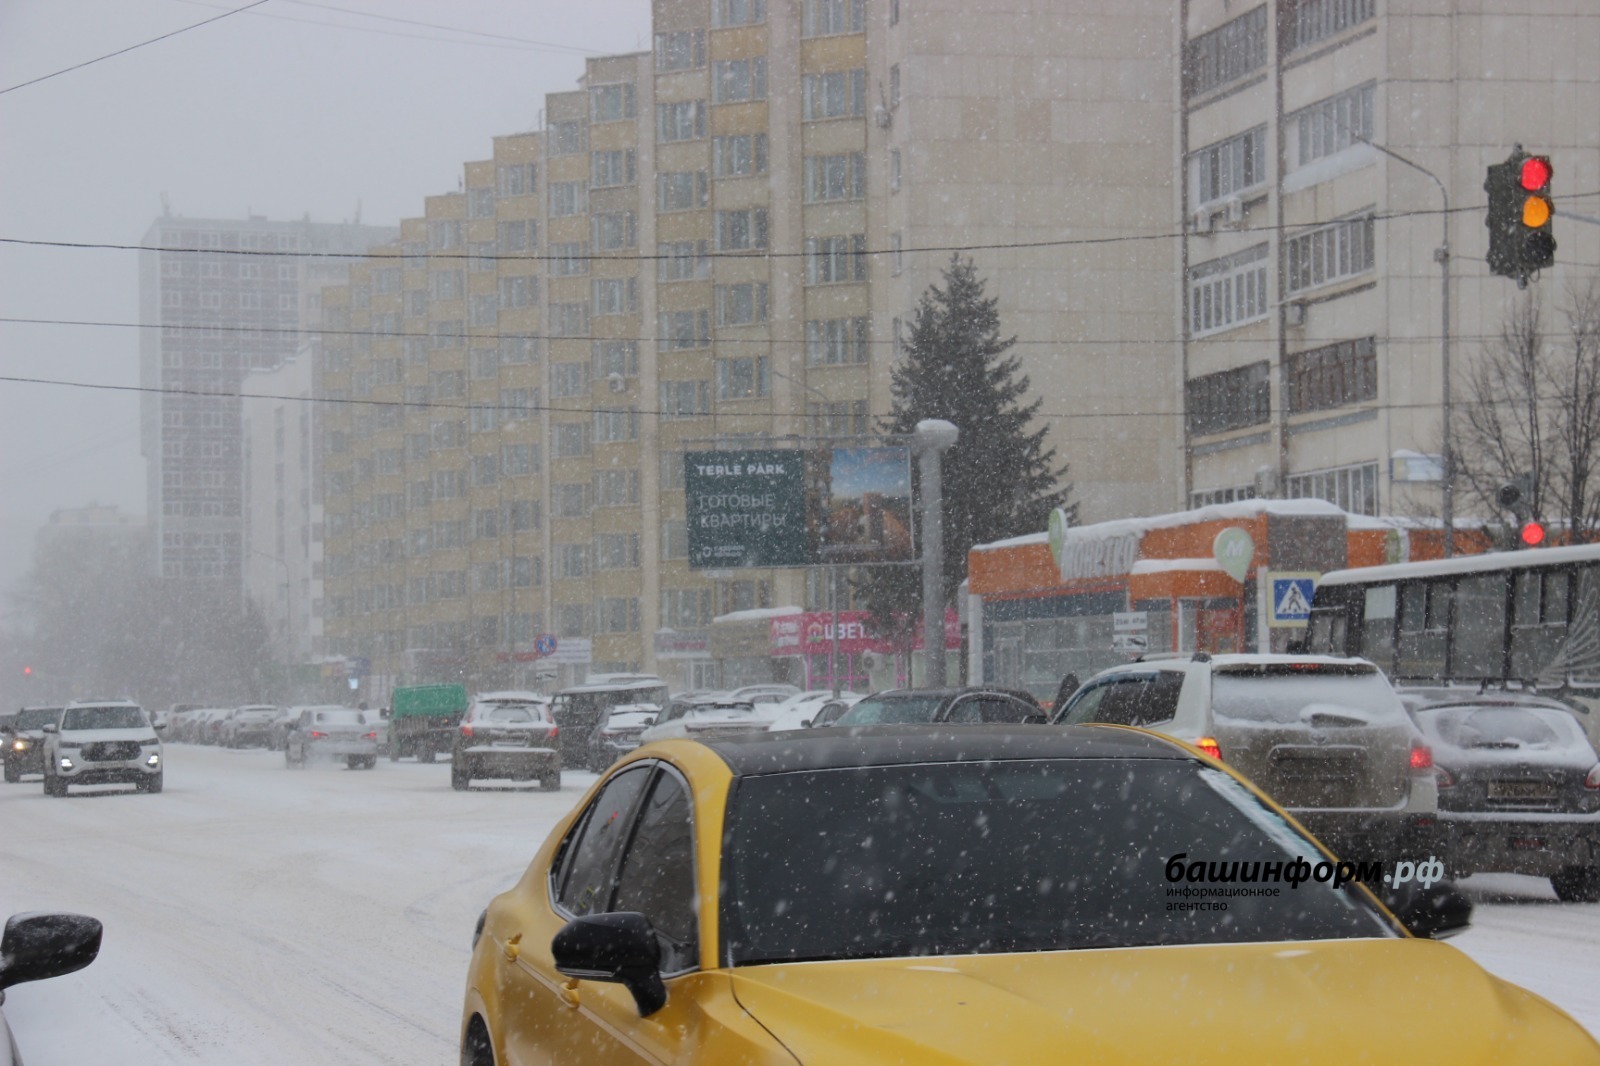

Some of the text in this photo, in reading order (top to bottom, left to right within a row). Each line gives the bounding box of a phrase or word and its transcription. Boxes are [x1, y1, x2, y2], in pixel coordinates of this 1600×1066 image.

[697, 463, 785, 476] TERLE PARK
[699, 494, 774, 509] ГОТОВЫЕ
[701, 513, 787, 529] КВАРТИРЫ
